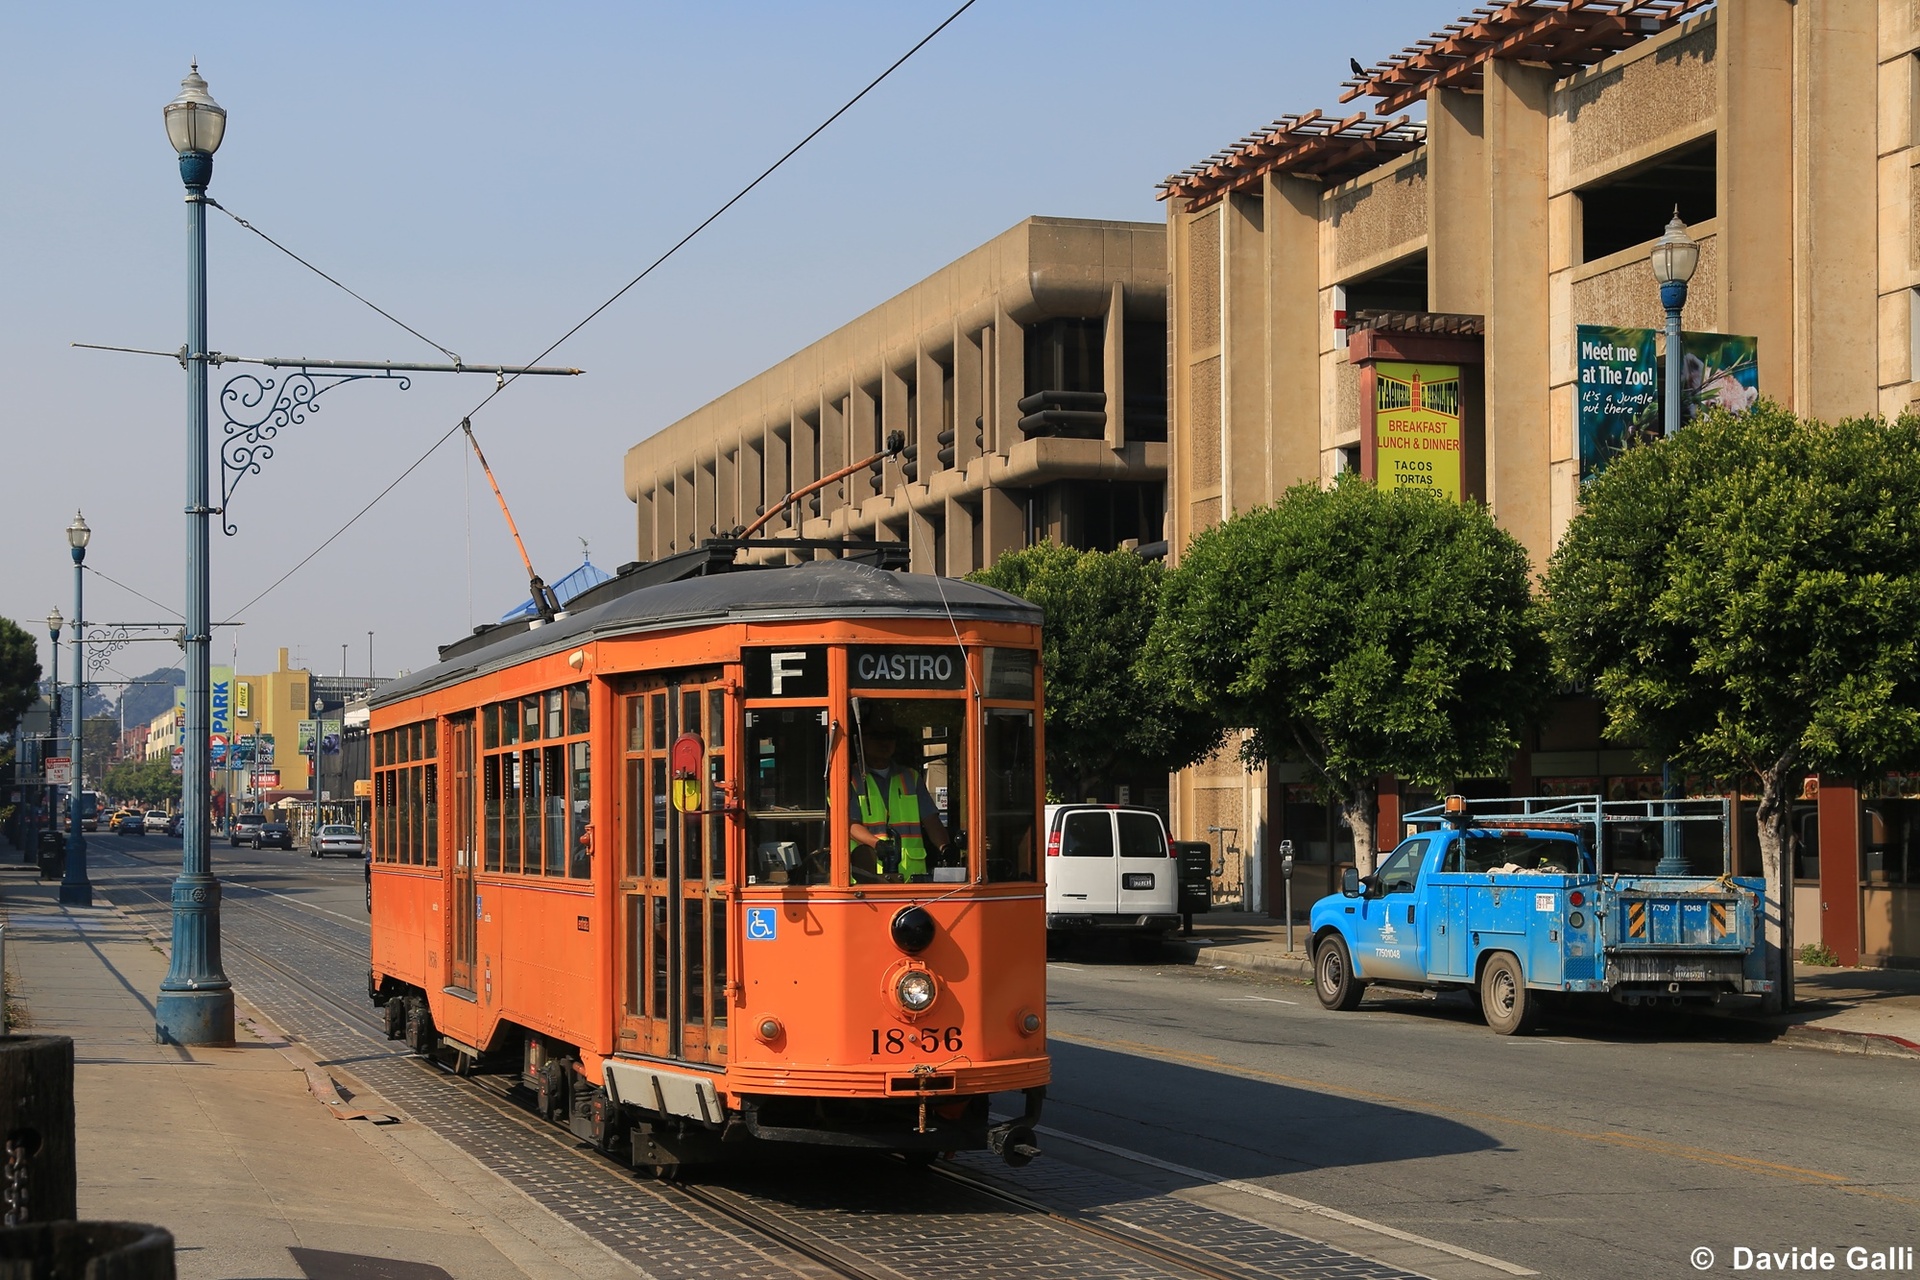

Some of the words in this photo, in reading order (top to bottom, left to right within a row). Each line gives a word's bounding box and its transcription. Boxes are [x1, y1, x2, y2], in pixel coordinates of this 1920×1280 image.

[1582, 341, 1613, 361] Meet
[1616, 347, 1637, 362] me
[1582, 366, 1596, 384] at
[1599, 366, 1622, 385] The
[1625, 367, 1653, 386] Zoo!
[1582, 390, 1601, 402] It's
[1605, 394, 1613, 403] a
[1616, 391, 1653, 405] jungle
[1582, 402, 1599, 414] out
[1388, 420, 1448, 434] BREAKFAST
[1377, 437, 1411, 449] LUNCH
[1413, 438, 1420, 450] &
[1422, 438, 1460, 451] DINNER
[1394, 460, 1433, 472] TACOS
[1395, 474, 1433, 485] TORTAS
[770, 651, 807, 695] F
[858, 653, 952, 680] CASTRO
[213, 681, 228, 733] PARK
[1375, 948, 1401, 959] 77501048
[871, 1027, 964, 1055] 1856
